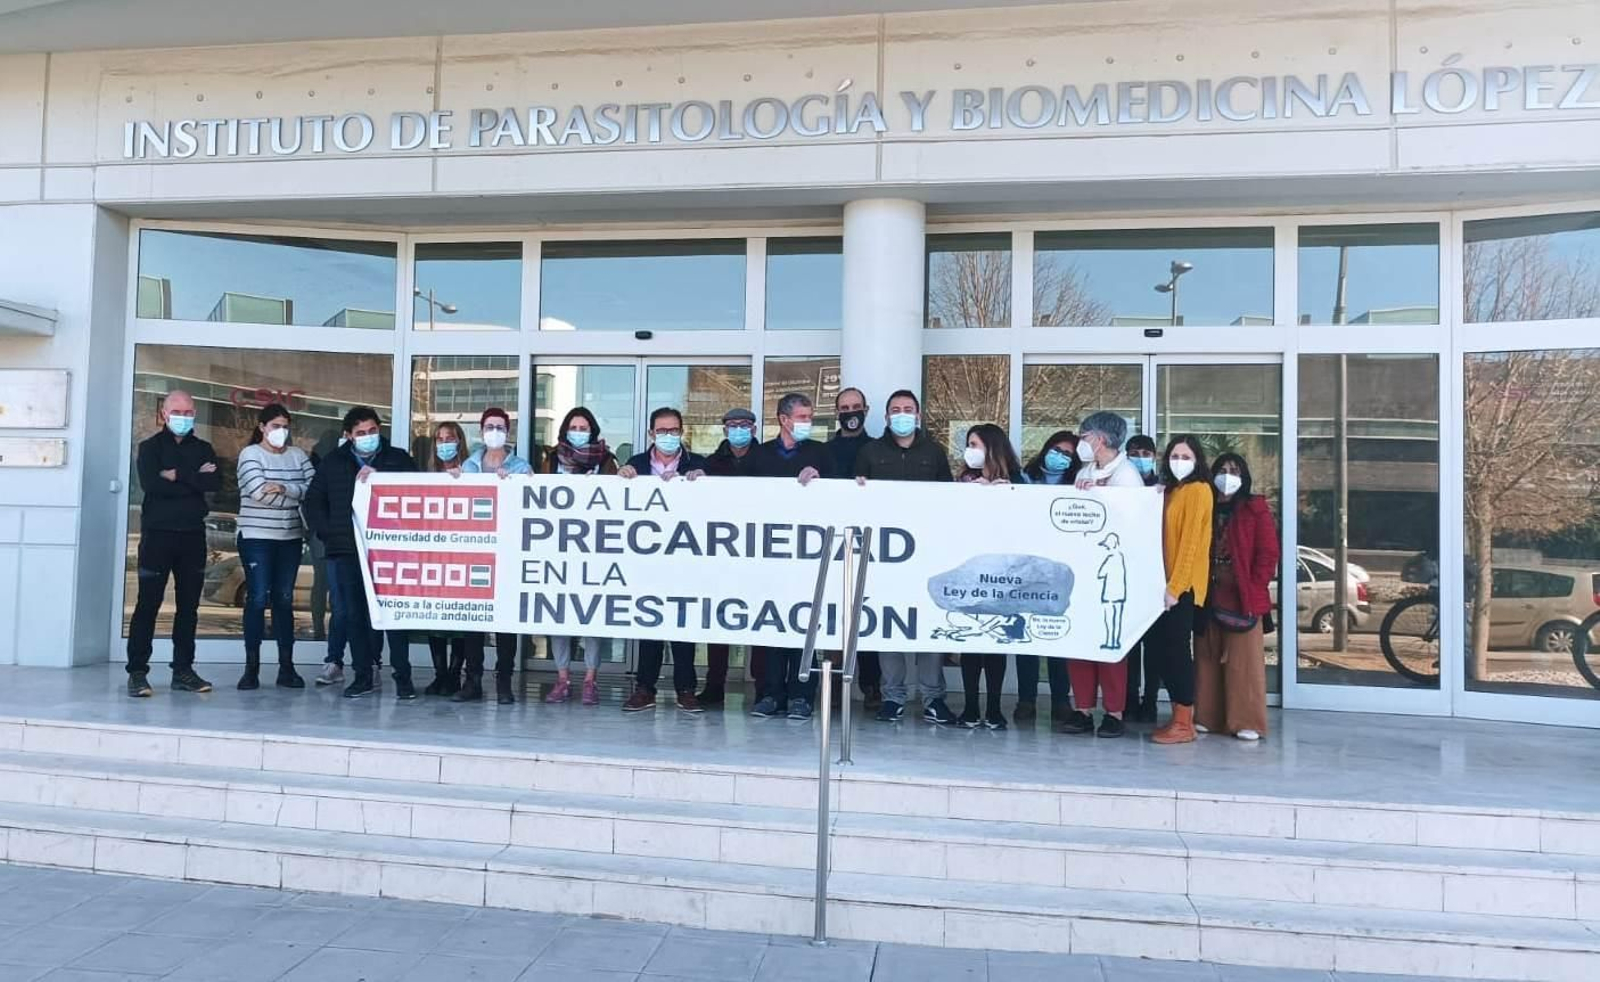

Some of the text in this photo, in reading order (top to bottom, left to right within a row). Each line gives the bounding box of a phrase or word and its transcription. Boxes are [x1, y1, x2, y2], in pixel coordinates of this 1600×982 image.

[124, 53, 1600, 160] INSTITUTO DE PARASITOLOGÍA Y BIOMEDICINA LÓPEZ
[377, 496, 469, 520] CCOO
[522, 485, 670, 512] NO A LA
[365, 530, 497, 545] Universidad de Granada
[521, 517, 917, 564] PRECARIEDAD
[373, 561, 466, 587] CCOO
[521, 560, 627, 587] EN LA
[979, 573, 1022, 585] Nueva
[412, 601, 420, 610] a
[422, 599, 432, 611] la
[943, 586, 1059, 601] Ley de la Ciencia
[518, 591, 918, 641] INVESTIGACIÓN
